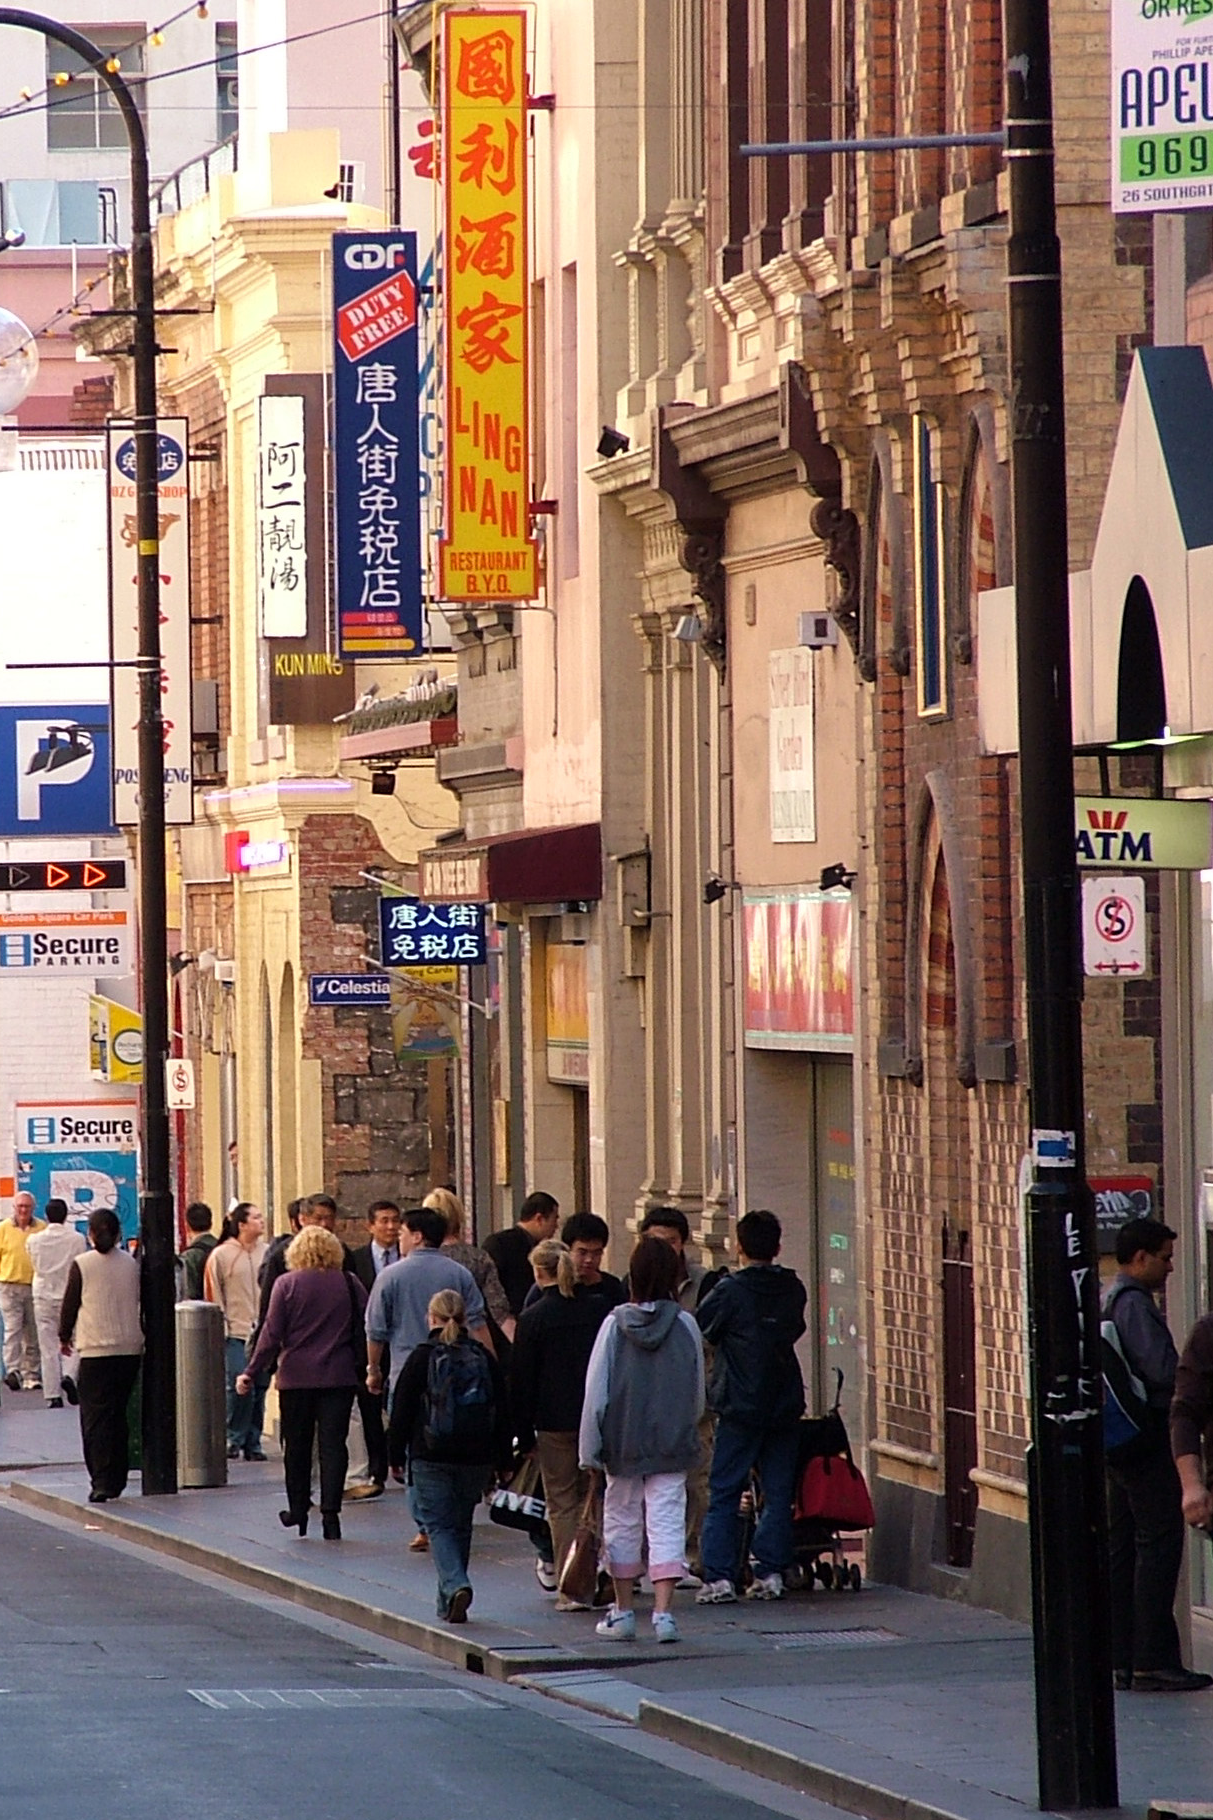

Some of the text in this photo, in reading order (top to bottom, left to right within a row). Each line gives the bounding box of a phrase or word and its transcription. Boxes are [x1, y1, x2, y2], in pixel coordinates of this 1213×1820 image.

[1142, 0, 1170, 19] OR
[1152, 48, 1190, 59] PHILLIP
[1138, 135, 1208, 177] 969
[1122, 189, 1140, 204] 26
[346, 281, 404, 328] DUTY
[350, 306, 409, 351] FREE
[456, 386, 521, 474] LING
[459, 465, 518, 538] NAN
[450, 551, 528, 572] RESTAURANT
[467, 573, 512, 594] B.Y.O.
[276, 654, 305, 677] KUN
[16, 719, 94, 821] P
[1076, 830, 1153, 862] ATM
[73, 911, 92, 921] Car
[93, 910, 116, 921] Park
[388, 904, 479, 930] 唐人街
[33, 932, 119, 956] Secure
[33, 955, 120, 966] PARKING
[60, 1116, 133, 1136] Secure
[60, 1136, 134, 1144] PARKING
